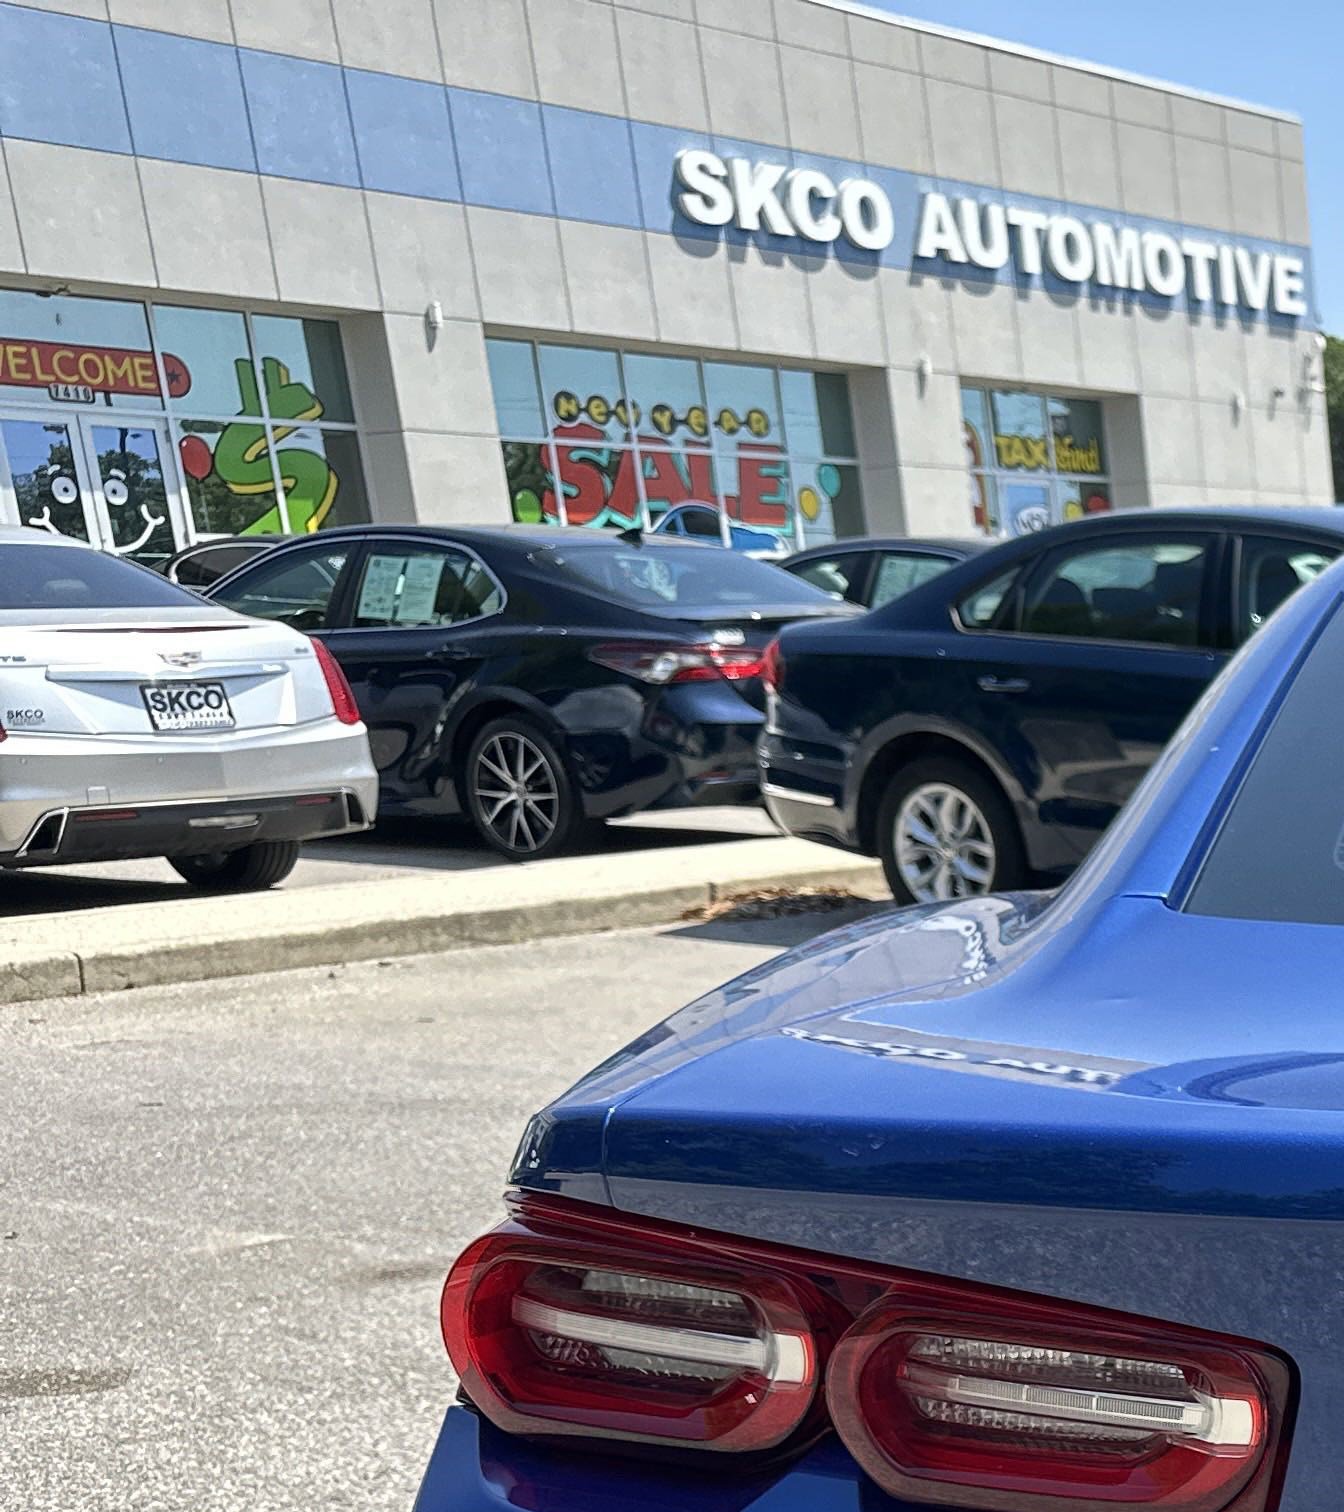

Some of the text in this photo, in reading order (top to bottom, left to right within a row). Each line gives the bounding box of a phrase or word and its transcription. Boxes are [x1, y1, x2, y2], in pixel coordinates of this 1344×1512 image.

[675, 147, 1308, 316] SKCO AUTOMOTIVE
[0, 345, 158, 389] ELCOME
[996, 435, 1049, 468] TAX
[541, 424, 788, 526] SALE
[7, 709, 44, 719] SKCO
[150, 690, 223, 713] SKCO
